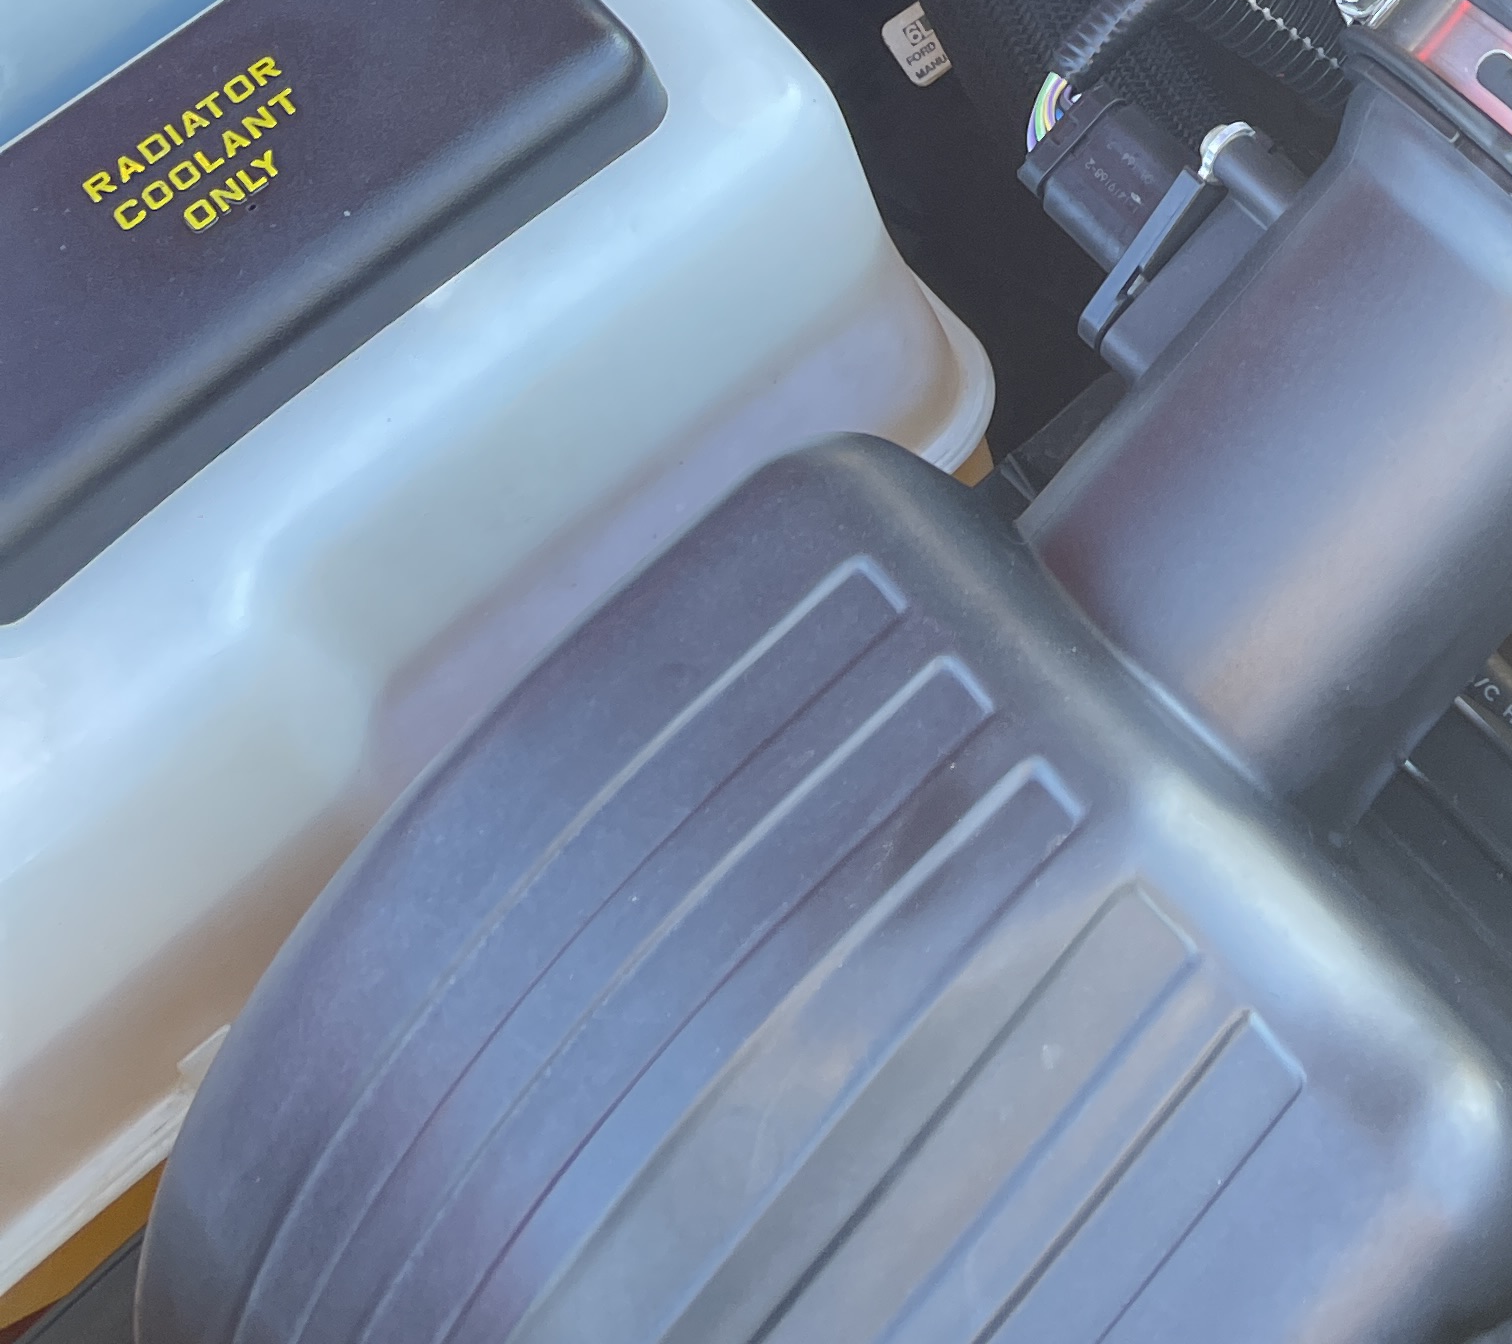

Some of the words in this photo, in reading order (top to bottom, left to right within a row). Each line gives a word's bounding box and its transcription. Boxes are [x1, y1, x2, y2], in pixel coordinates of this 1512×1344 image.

[906, 42, 936, 66] FORD
[82, 56, 281, 202] RADIATOR
[113, 88, 297, 230] COOLANT
[183, 150, 280, 231] ONLY
